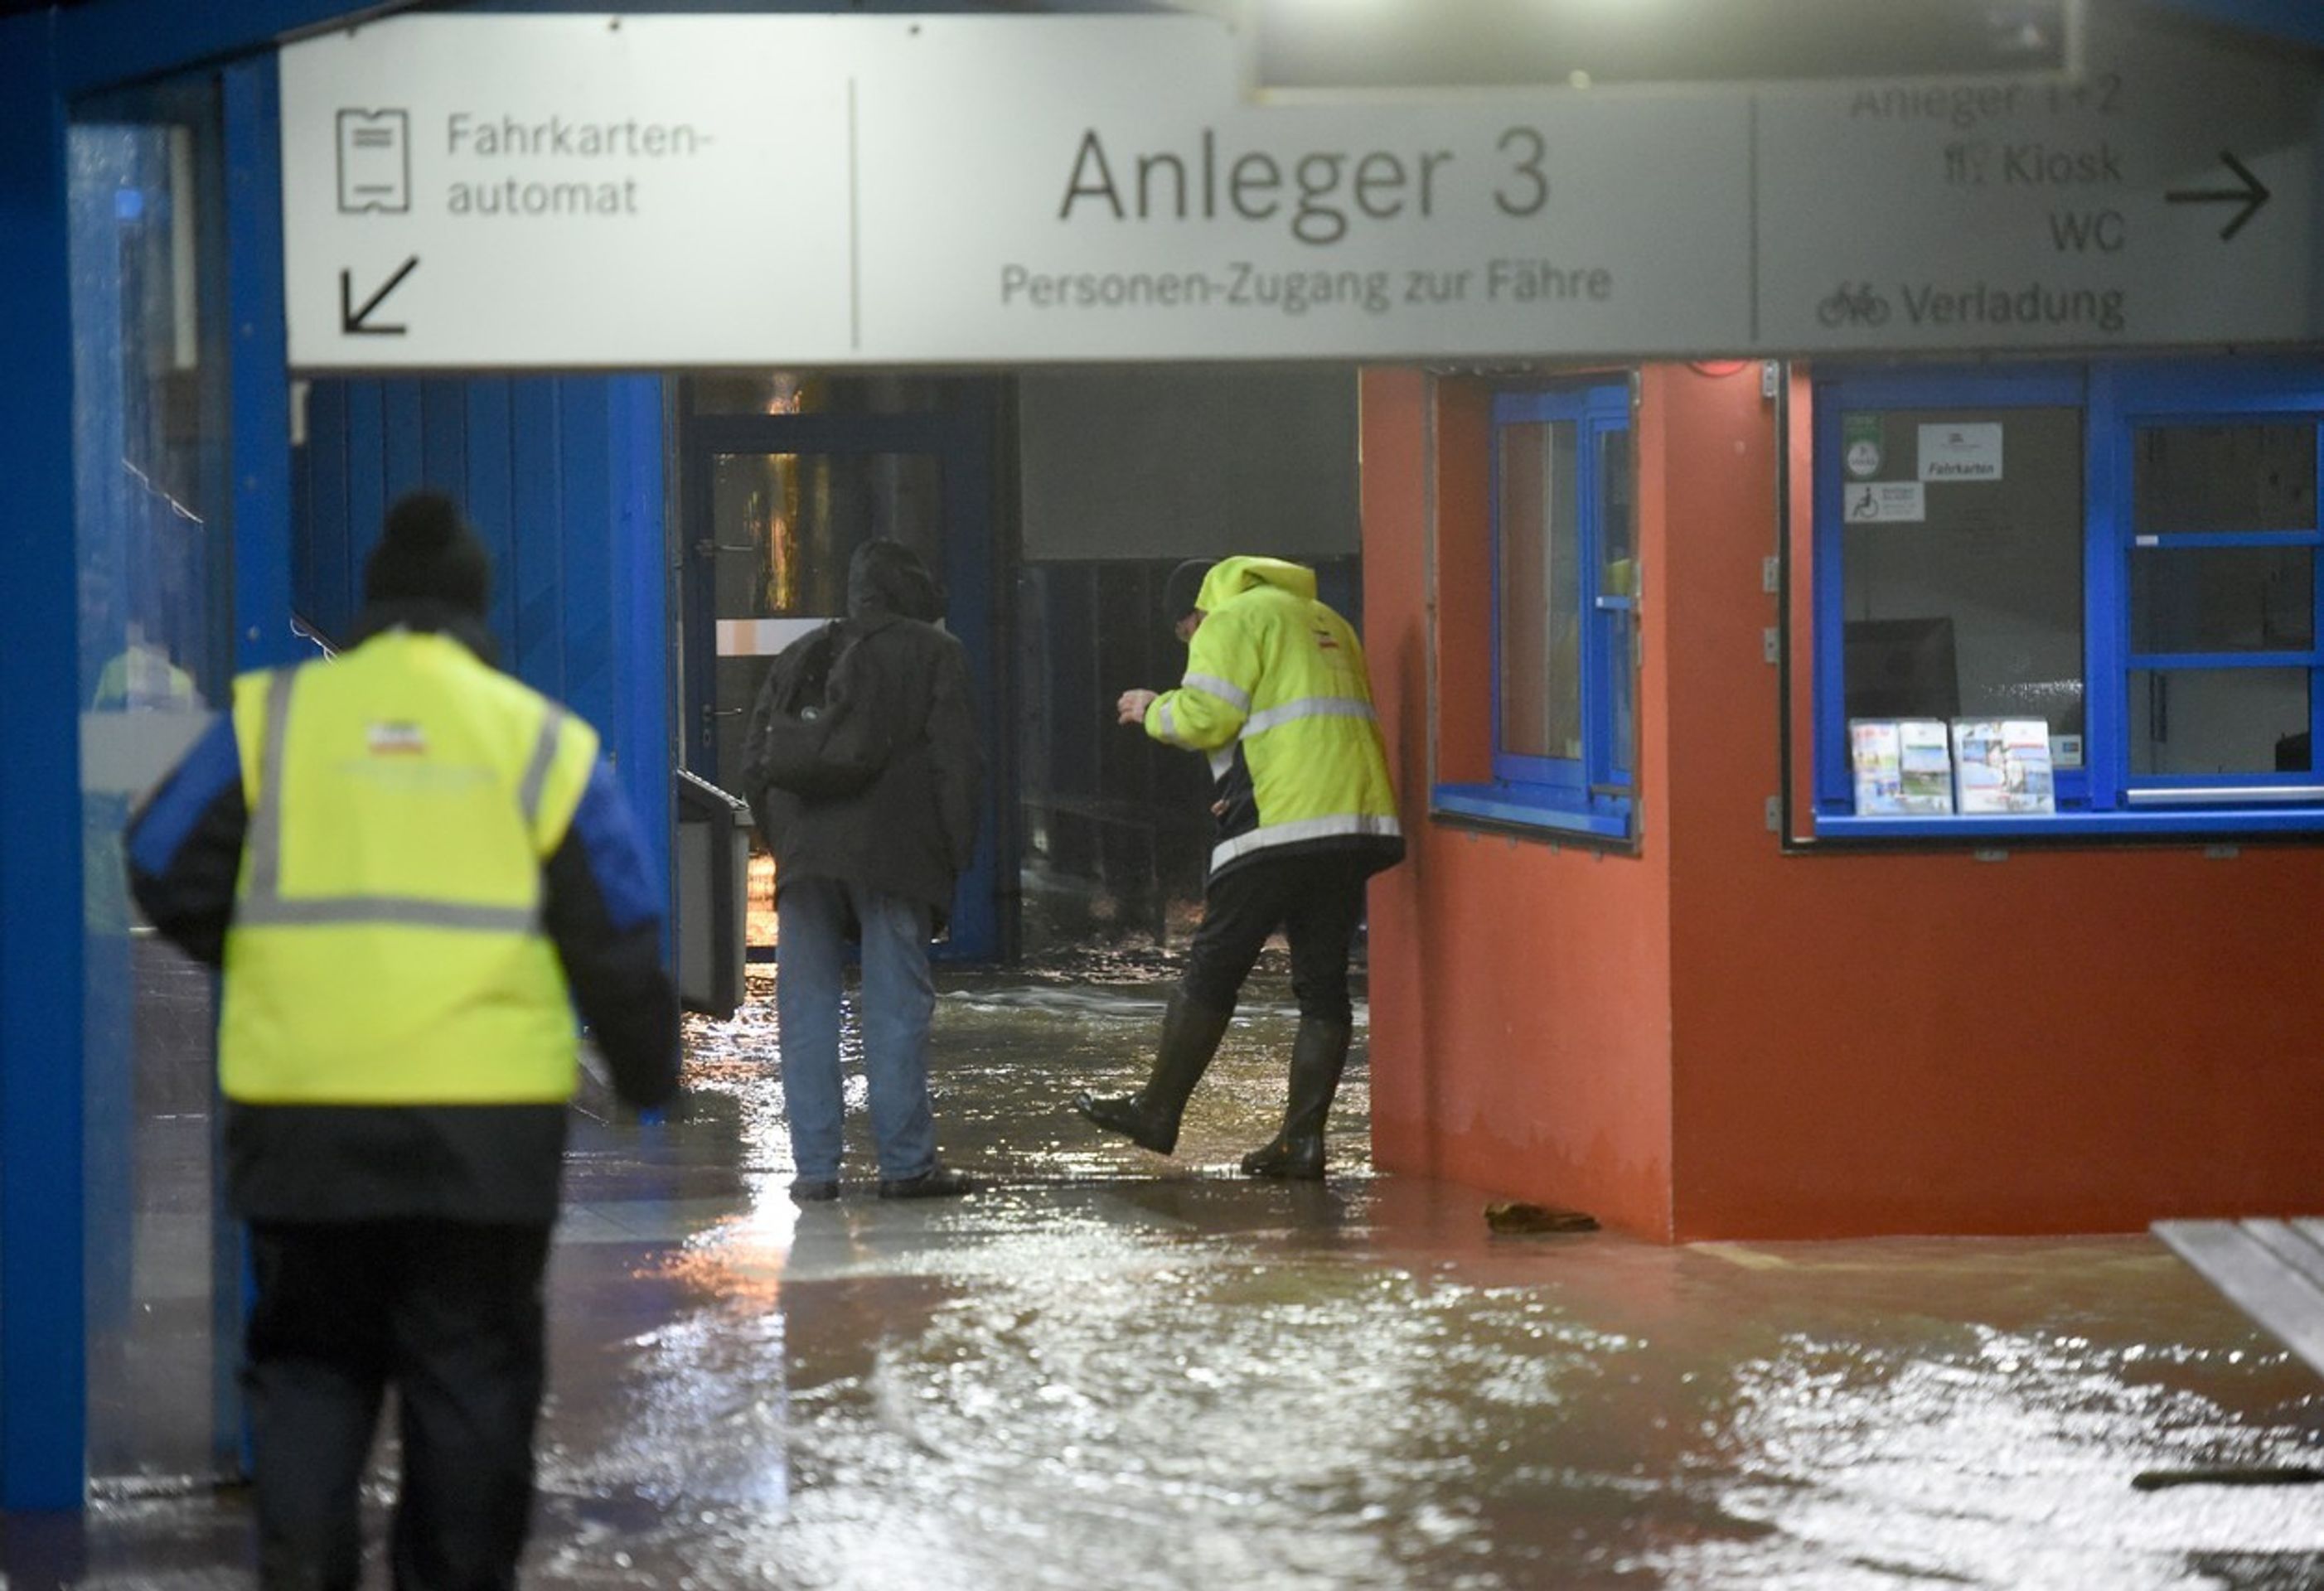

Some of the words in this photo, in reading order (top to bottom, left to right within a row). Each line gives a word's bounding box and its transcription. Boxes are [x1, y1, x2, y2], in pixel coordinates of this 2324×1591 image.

[1851, 83, 2022, 128] Anleger
[447, 113, 715, 157] Fahrkarten-
[2003, 142, 2124, 184] Kiosk
[447, 179, 638, 215] automat
[1058, 128, 1456, 246] Anleger
[1494, 125, 1551, 218] 3
[2048, 209, 2126, 253] WC
[1000, 262, 1392, 315] Personen-Zugang
[1405, 268, 1472, 302] zur
[1490, 259, 1613, 302] Fähre
[1900, 281, 2126, 332] Verladung
[1928, 461, 1995, 476] Fahrkarten
